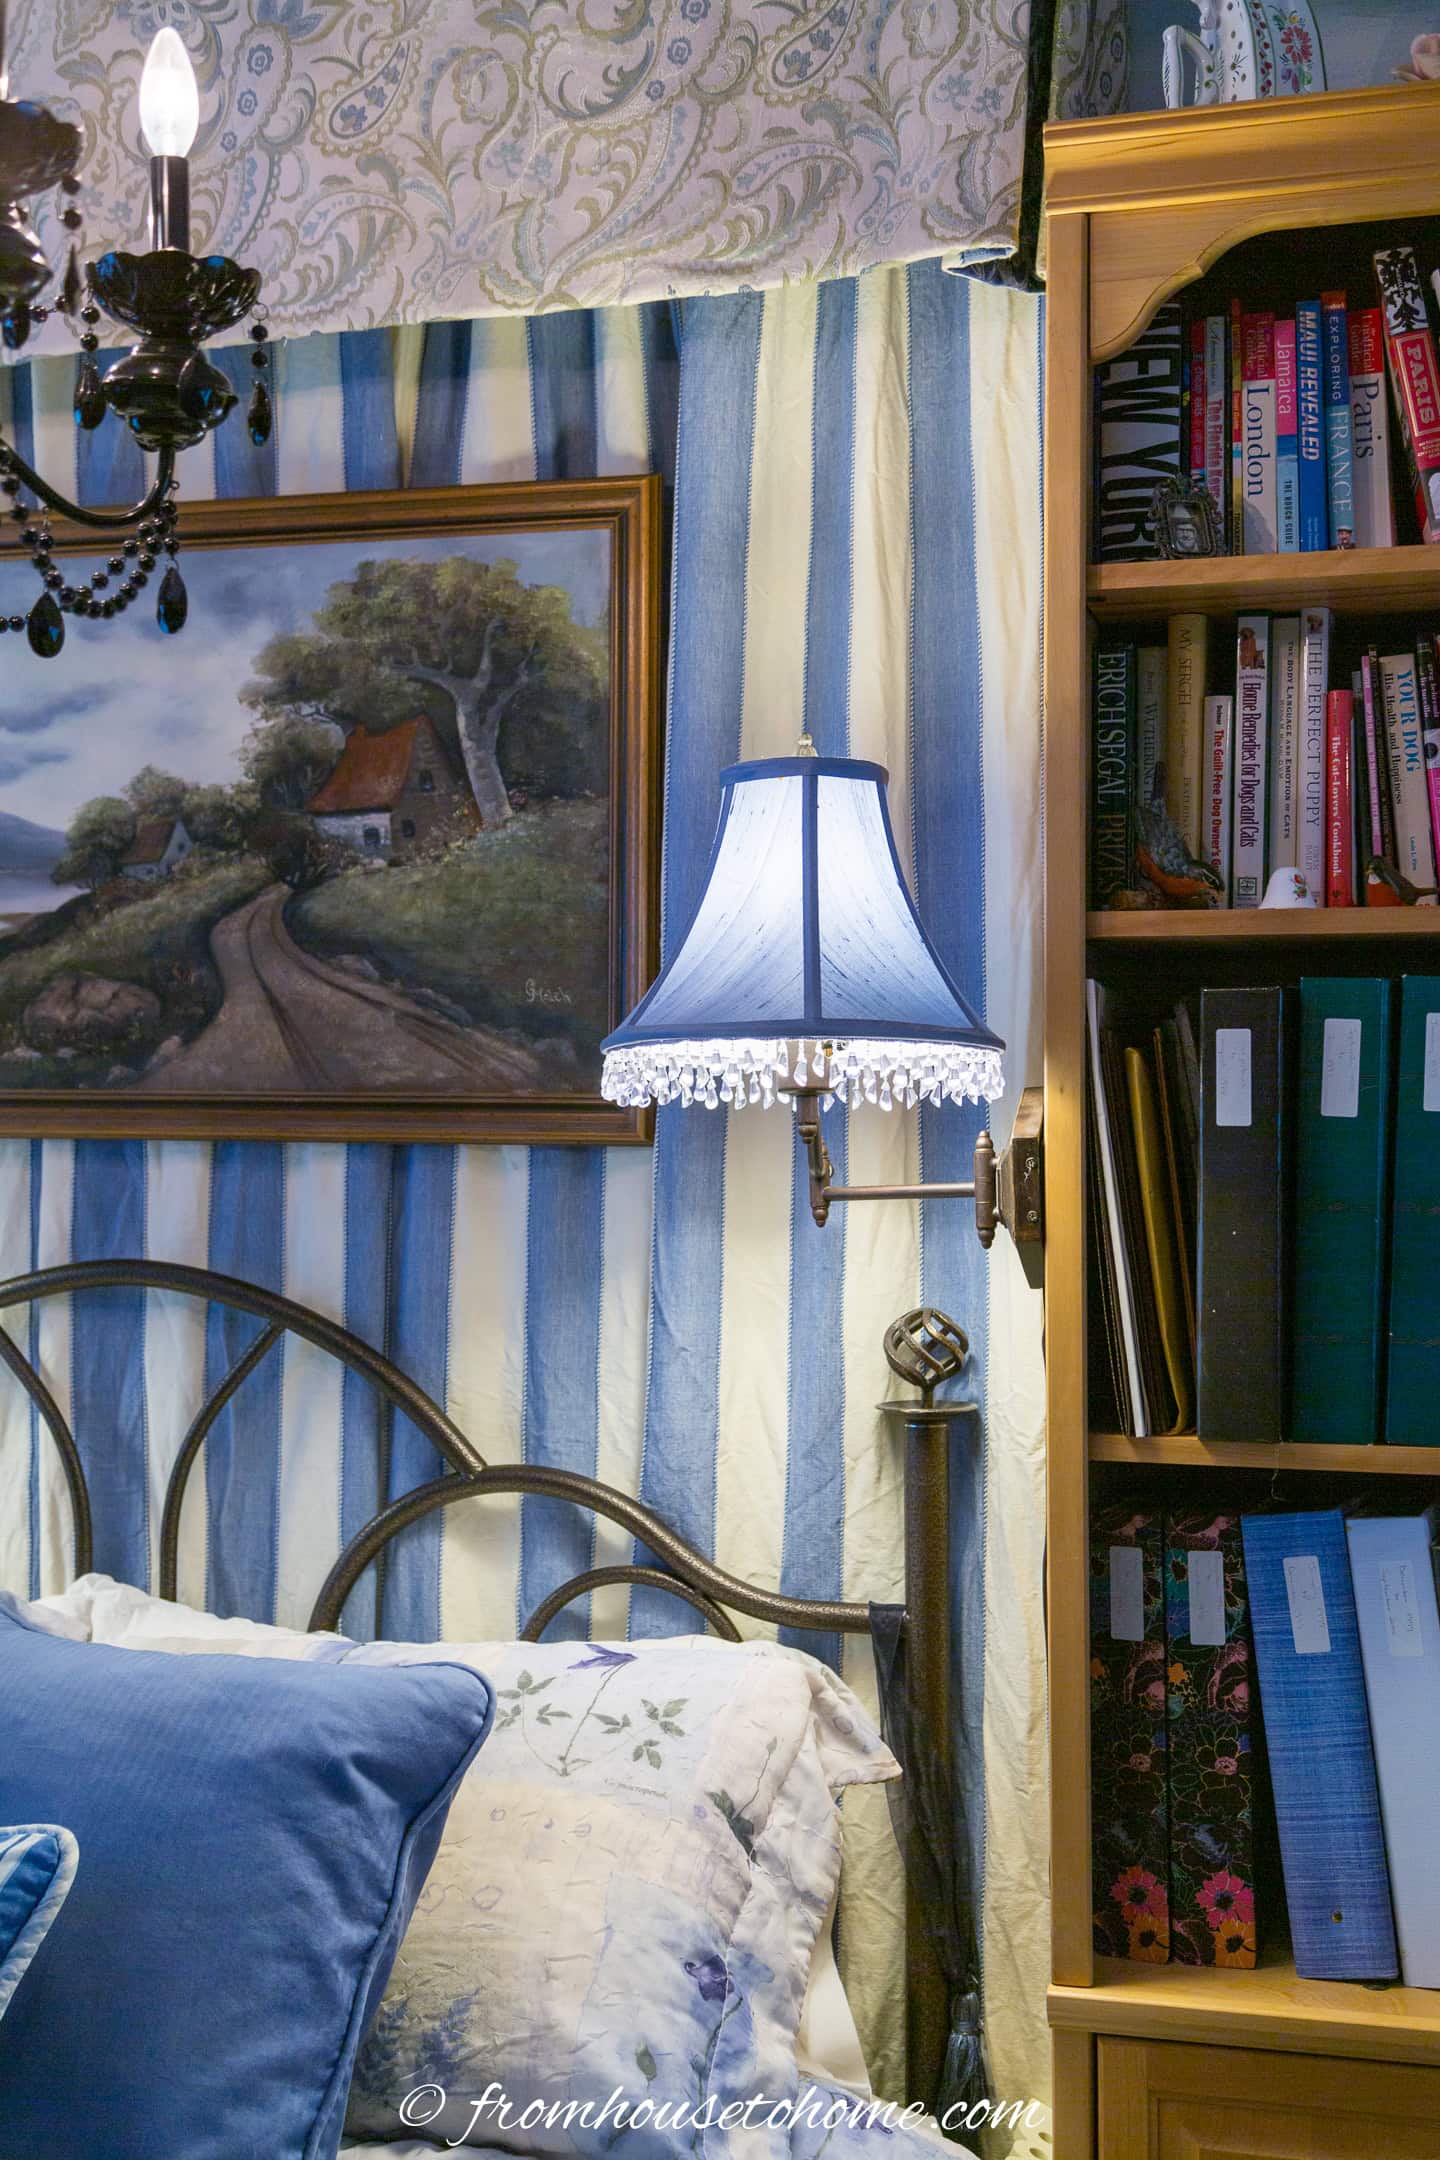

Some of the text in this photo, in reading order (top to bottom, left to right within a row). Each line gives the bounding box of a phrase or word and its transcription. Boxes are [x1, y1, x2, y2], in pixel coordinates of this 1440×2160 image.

[1277, 340, 1294, 414] Jamaica
[1329, 315, 1342, 401] EXPLORING
[1299, 311, 1319, 460] MAUI REVEALED
[1406, 346, 1436, 424] PARIS
[1208, 400, 1223, 422] The
[1352, 380, 1380, 459] Paris
[1247, 387, 1270, 497] London
[1330, 411, 1351, 513] FRANCE
[1284, 480, 1293, 544] THE ROUGH GUIDE
[1179, 629, 1191, 651] MY
[1177, 657, 1192, 705] SERGEI
[1286, 659, 1294, 684] BODY
[1243, 683, 1261, 710] Home
[1285, 686, 1294, 736] LANGUAGE
[1143, 703, 1158, 785] WUTHERING
[1214, 730, 1224, 747] The
[1241, 713, 1261, 760] Remedies
[1306, 639, 1322, 828] THE PERFECT PUPPY
[1384, 673, 1403, 805] His Health and Happiness
[1397, 669, 1420, 773] YOUR DOG
[1241, 763, 1261, 776] for
[1332, 736, 1341, 756] The
[1097, 653, 1127, 894] ERICH SEGAL PRIZES
[1212, 749, 1223, 795] Guilt-Free
[1238, 779, 1259, 805] Dogs
[1284, 759, 1292, 801] EMOTION
[1332, 758, 1341, 817] Cat-Lovers'
[1210, 799, 1222, 816] Dog
[1241, 805, 1259, 824] and
[1283, 815, 1291, 840] CATS
[1211, 819, 1222, 858] Owner's
[1240, 826, 1258, 847] Cats
[1332, 822, 1342, 876] Cookbook
